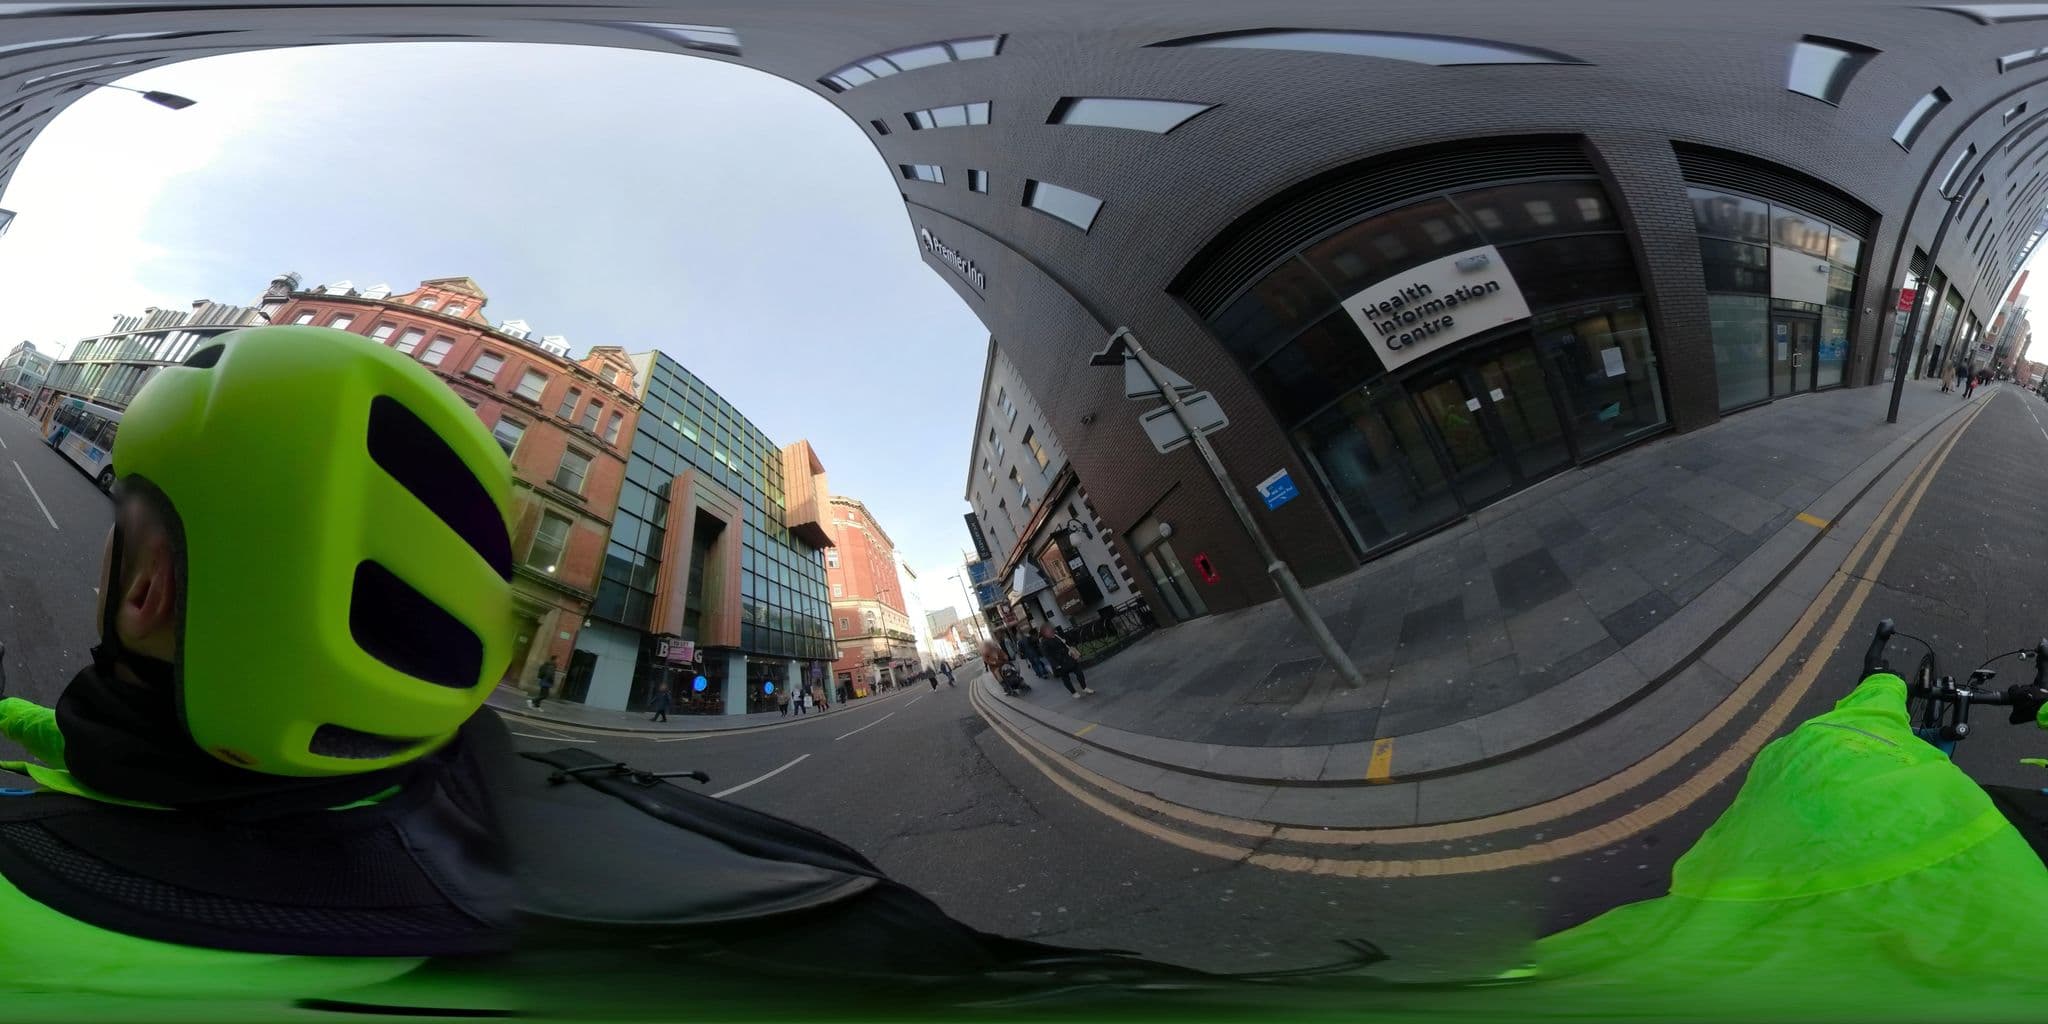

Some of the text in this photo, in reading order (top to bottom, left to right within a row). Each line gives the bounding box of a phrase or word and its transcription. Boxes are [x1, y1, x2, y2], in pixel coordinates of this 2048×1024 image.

[933, 236, 984, 290] Premier Inn
[1361, 283, 1433, 321] Health
[1373, 280, 1501, 337] Information
[1385, 315, 1454, 351] Centre
